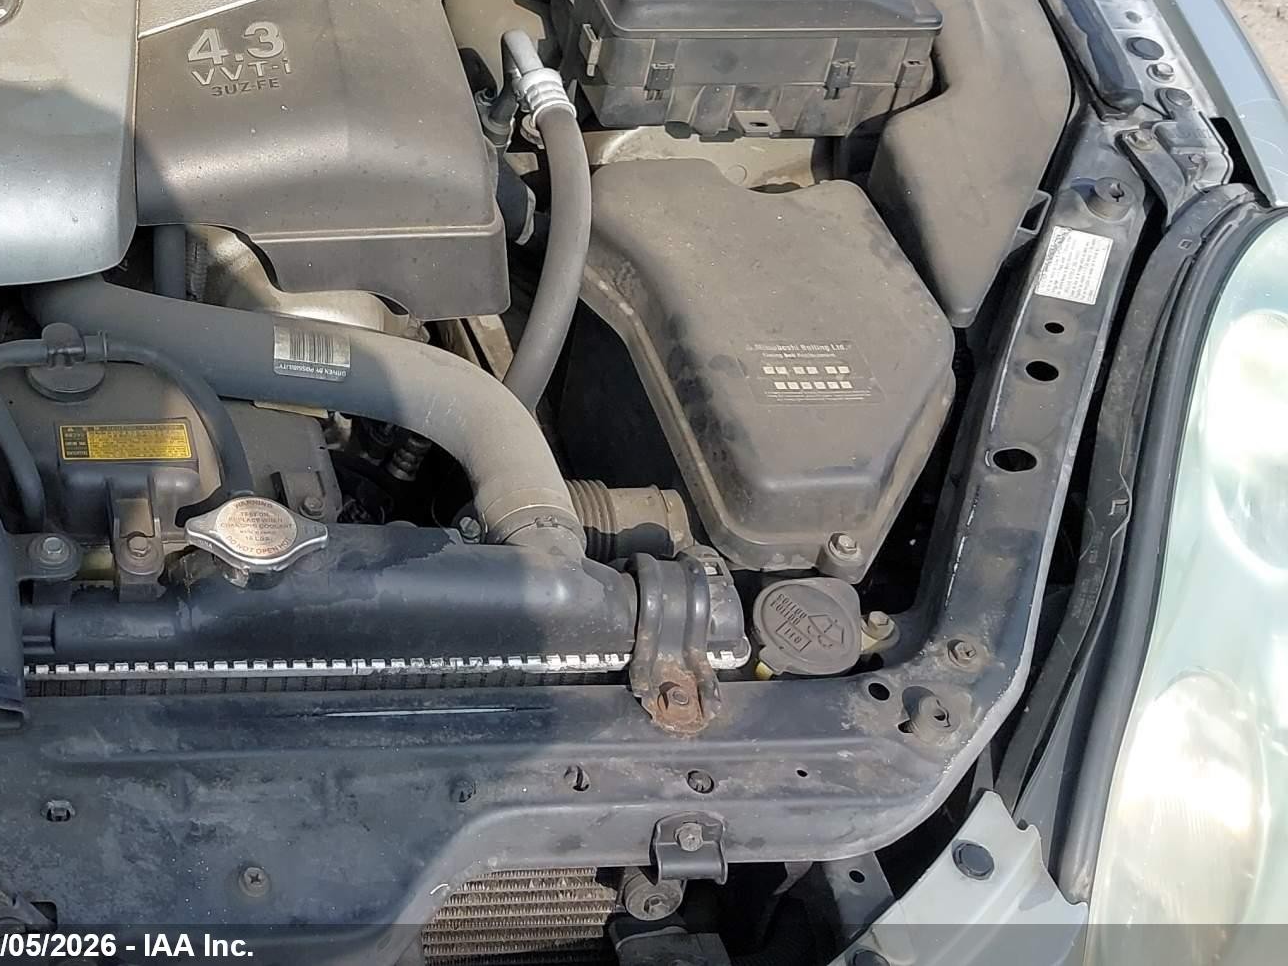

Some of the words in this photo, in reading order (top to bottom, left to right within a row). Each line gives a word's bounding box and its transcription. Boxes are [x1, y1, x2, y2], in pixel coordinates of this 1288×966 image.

[187, 21, 285, 65] 4.3
[191, 57, 292, 86] VVT-i
[211, 78, 280, 96] 3UZ-FE
[256, 545, 278, 555] OPEN
